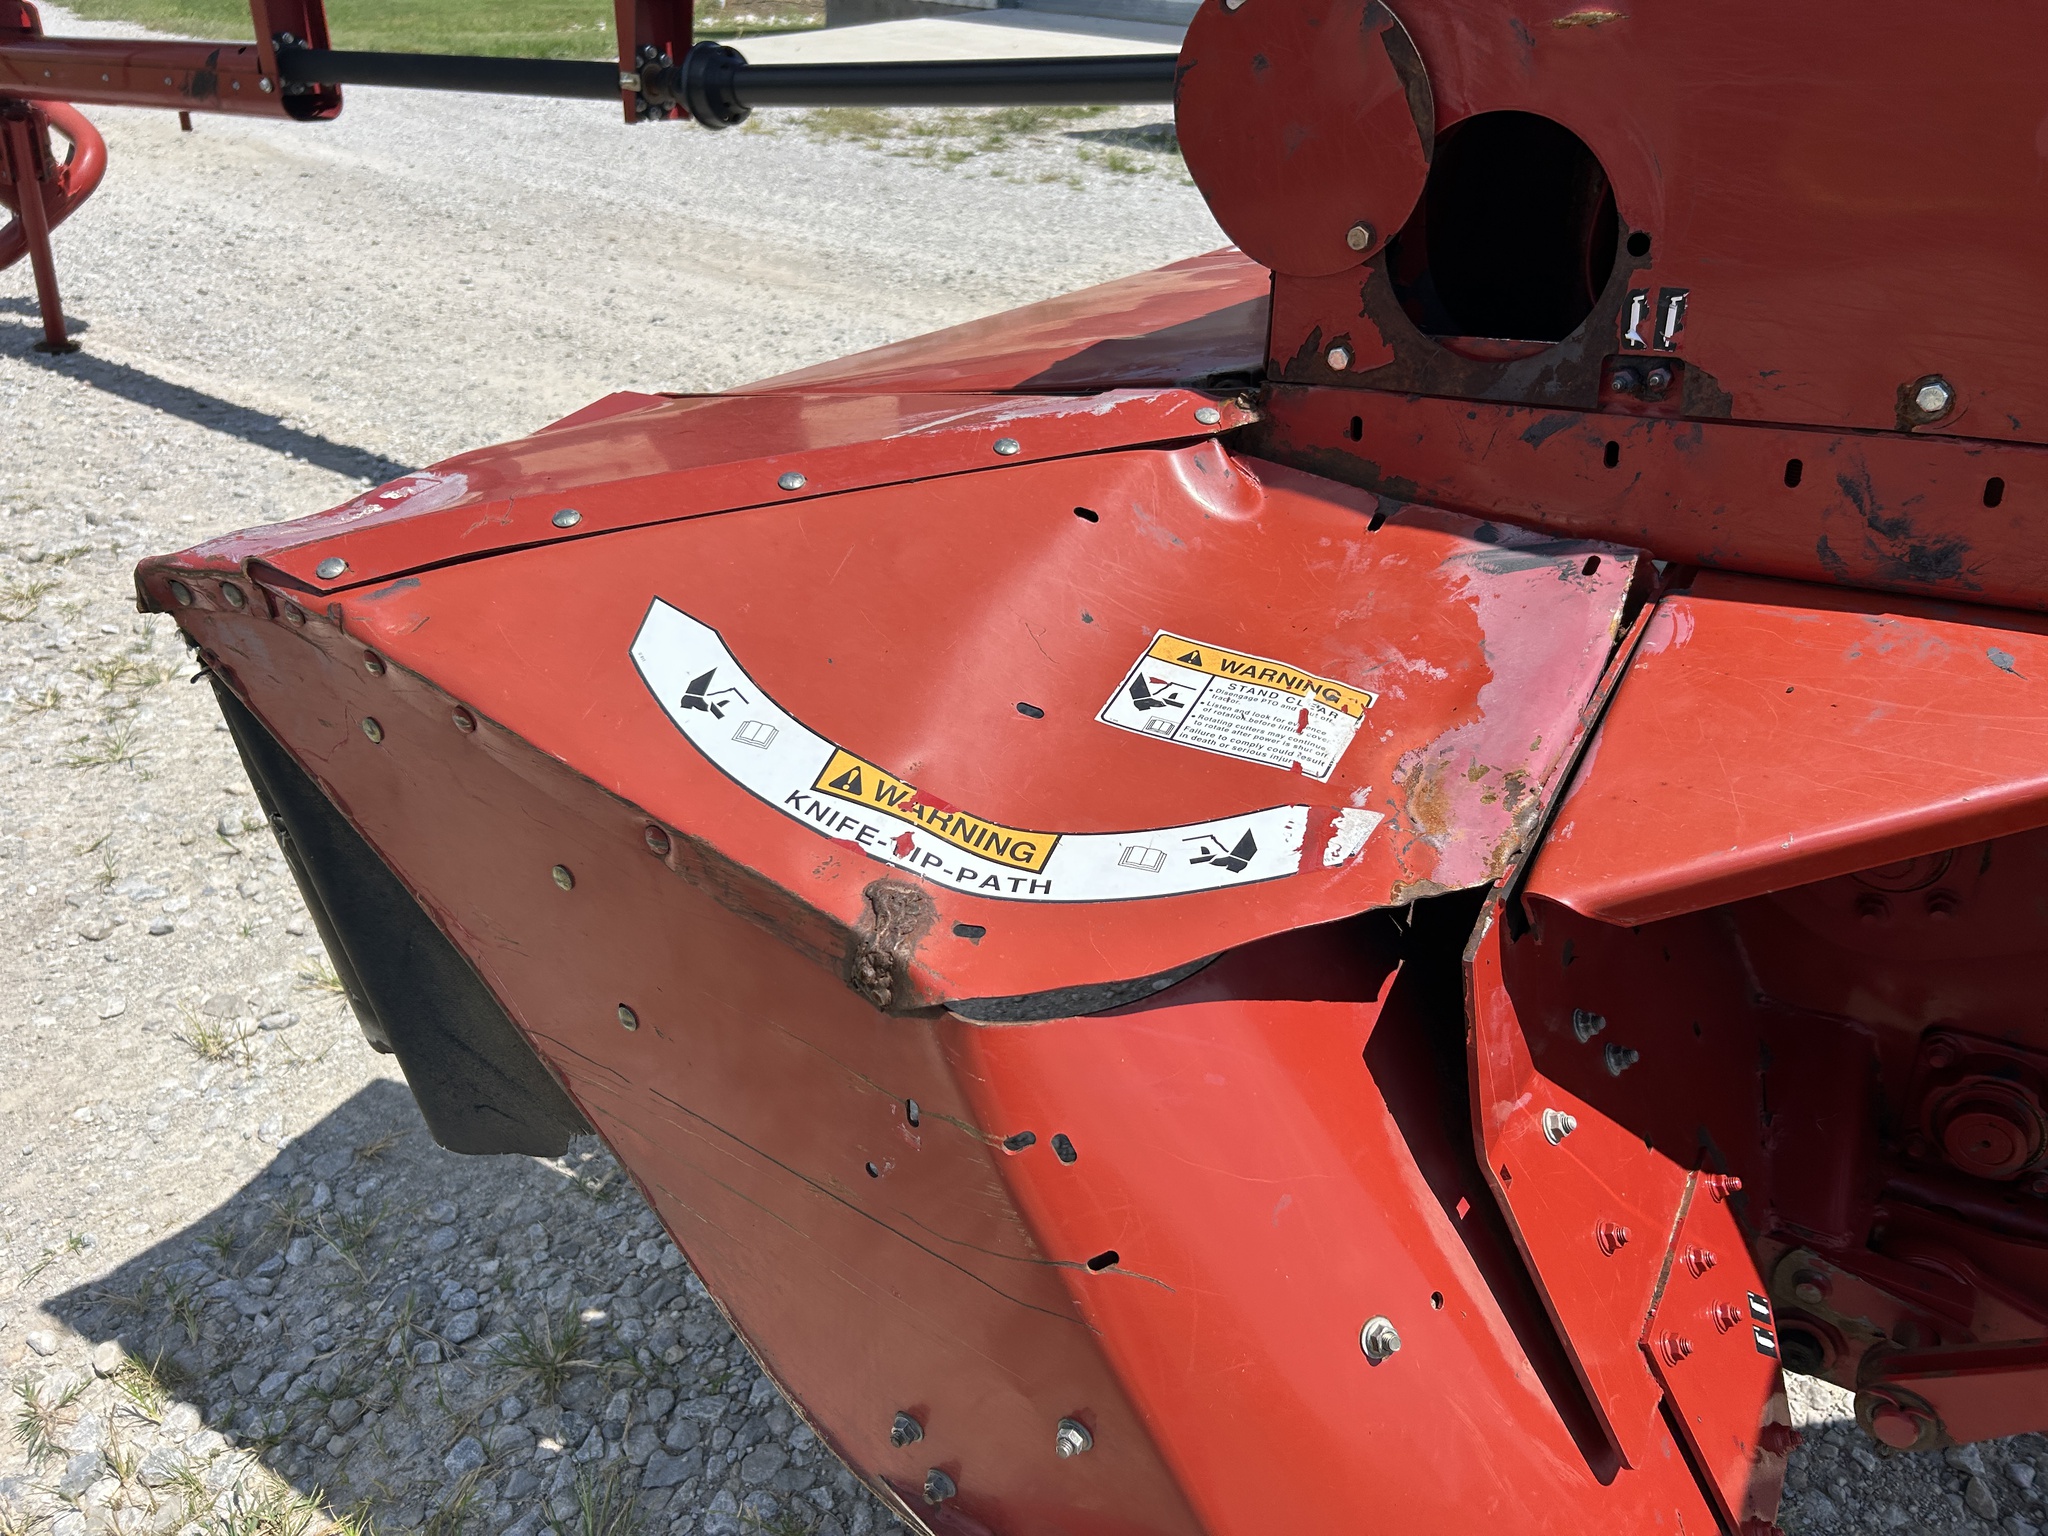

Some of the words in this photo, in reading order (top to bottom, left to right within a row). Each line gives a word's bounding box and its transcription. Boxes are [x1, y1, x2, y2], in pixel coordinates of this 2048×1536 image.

[1220, 658, 1342, 704] WARNING
[1228, 683, 1279, 699] STAND
[1215, 688, 1259, 702] Disengage
[1260, 698, 1279, 707] PTO
[1280, 703, 1297, 711] and
[1197, 714, 1233, 728] Rotating
[1235, 723, 1265, 734] cutters
[1267, 730, 1286, 740] may
[1287, 736, 1326, 751] continue
[1206, 701, 1232, 711] Listen
[1234, 708, 1251, 716] and
[1252, 711, 1271, 721] look
[1287, 721, 1327, 735] evence
[1213, 710, 1246, 721] rotation
[1248, 717, 1276, 728] before
[1183, 725, 1216, 738] Failure
[1229, 738, 1264, 750] comply
[1266, 746, 1295, 757] could
[1190, 735, 1217, 746] death
[1231, 746, 1267, 757] serious
[1269, 753, 1292, 764] injur
[1194, 719, 1203, 727] to
[1204, 723, 1230, 732] rotate
[1231, 729, 1252, 738] after
[1252, 734, 1280, 745] power
[1293, 744, 1313, 753] shut
[784, 789, 1053, 895] KNIFE-IP-PATH
